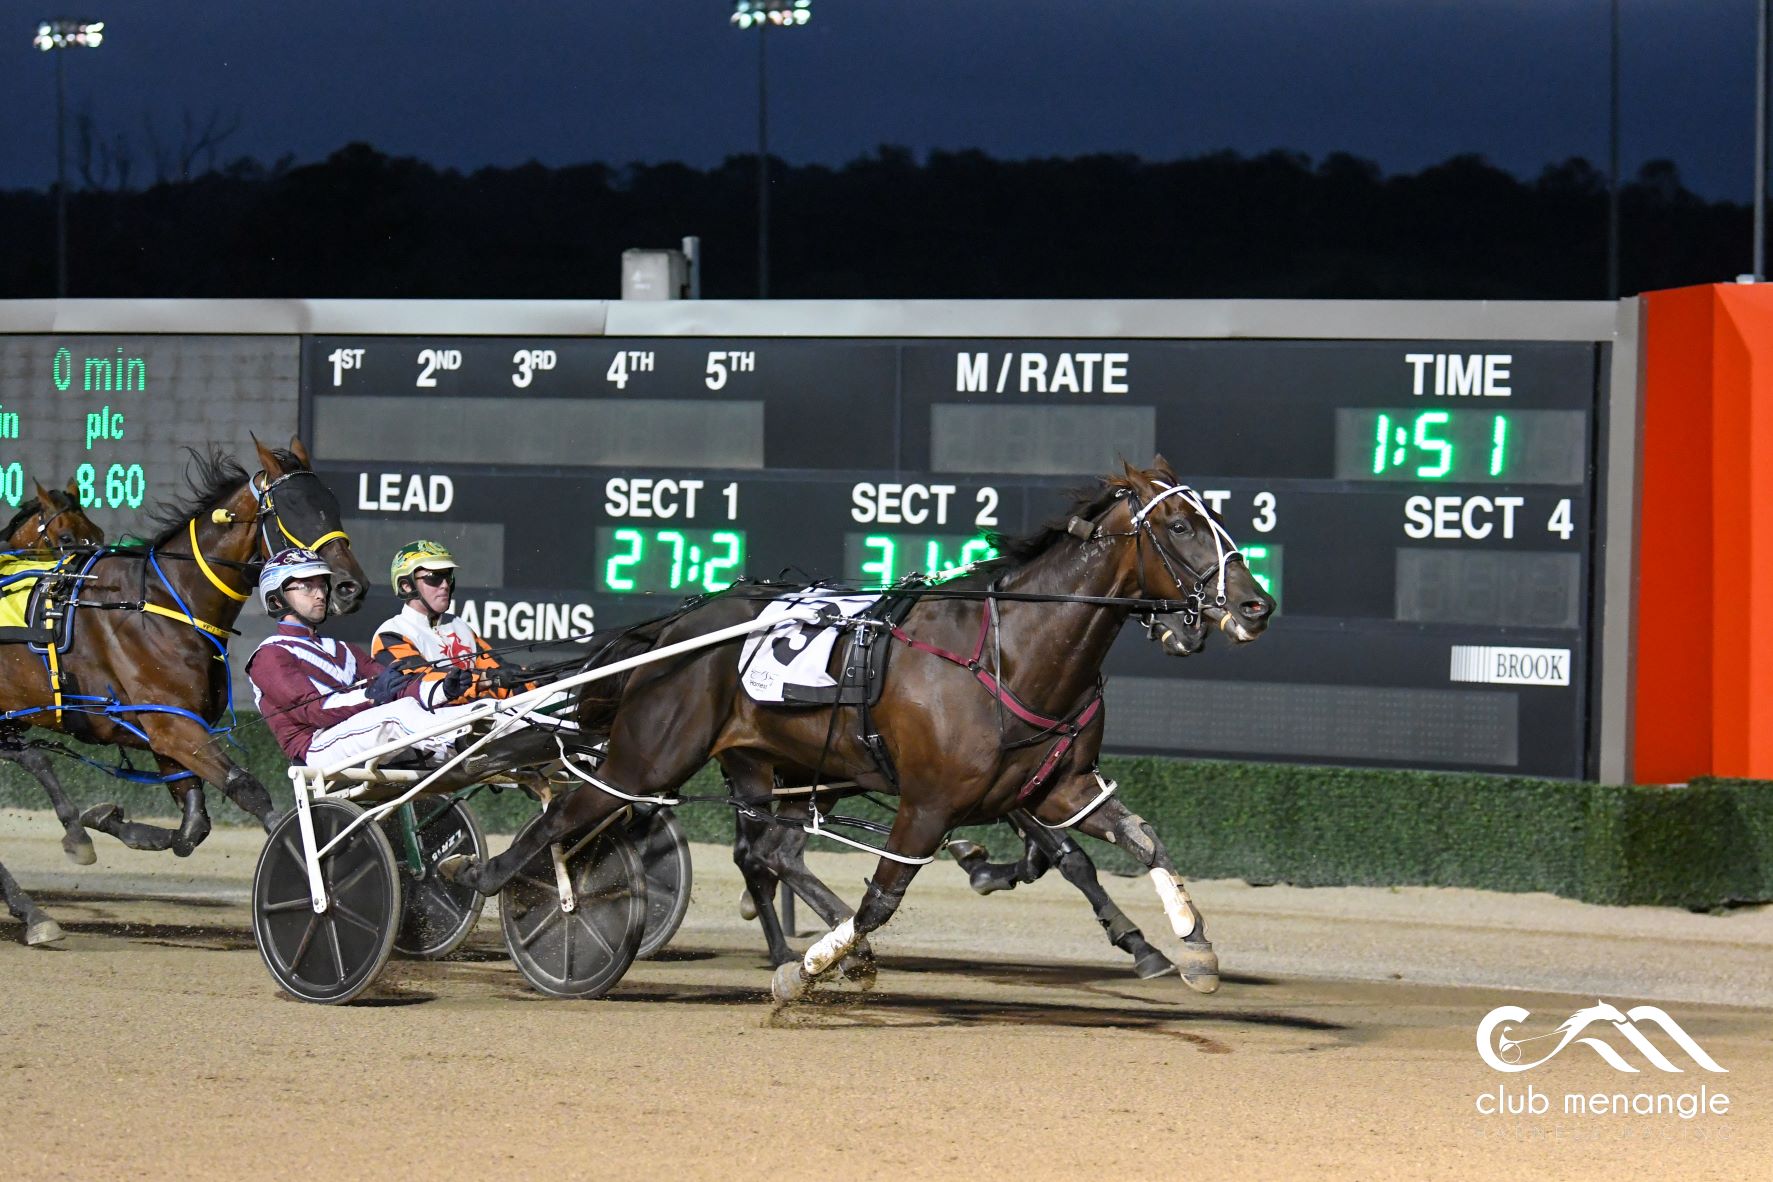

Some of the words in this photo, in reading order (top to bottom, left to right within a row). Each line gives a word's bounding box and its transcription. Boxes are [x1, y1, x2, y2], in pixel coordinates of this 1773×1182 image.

[84, 347, 146, 391] min
[328, 348, 365, 387] 1ST
[416, 349, 462, 388] 2ND
[512, 350, 557, 388] 3RD
[606, 351, 655, 389] 4TH
[705, 351, 755, 390] 5TH
[1405, 354, 1512, 396] TIME
[86, 405, 125, 450] plc
[0, 462, 23, 507] 0
[76, 463, 146, 509] 8.60
[358, 472, 454, 513] LEAD
[605, 478, 703, 518] SECT
[722, 482, 738, 520] 1
[851, 482, 956, 526] SECT
[975, 487, 999, 527] 2
[1252, 491, 1277, 533] 3
[1403, 495, 1524, 539] SECT
[1547, 498, 1574, 540] 4
[605, 528, 742, 593] 27:2
[445, 598, 595, 644] ARGINS
[1495, 653, 1564, 680] BROOK
